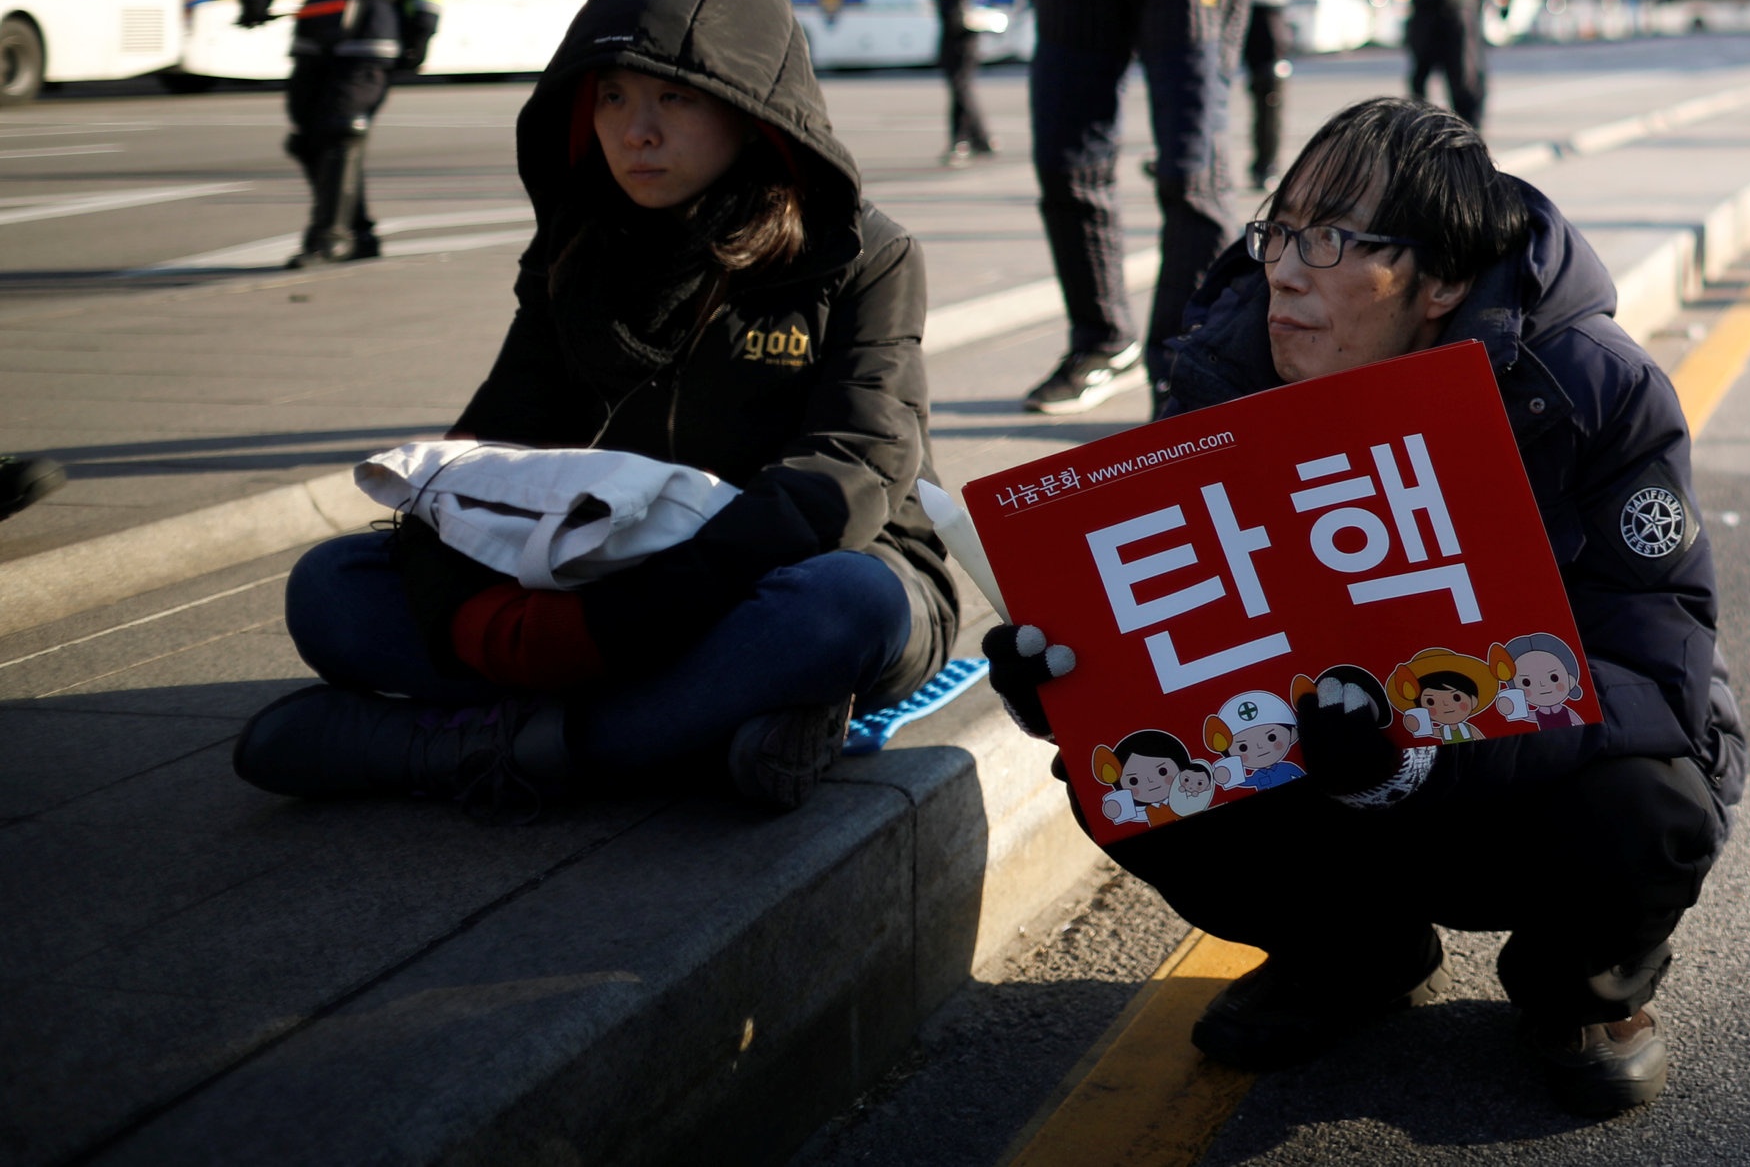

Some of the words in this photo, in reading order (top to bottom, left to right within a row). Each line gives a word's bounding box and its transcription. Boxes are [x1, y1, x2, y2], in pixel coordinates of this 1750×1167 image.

[743, 324, 808, 361] god
[996, 467, 1081, 509] 나눔문화
[1087, 430, 1235, 484] www.nanum.com
[1625, 489, 1683, 523] CALIFORNIA
[1622, 524, 1682, 554] LIFESTYLE
[1085, 432, 1483, 695] 탄핵
